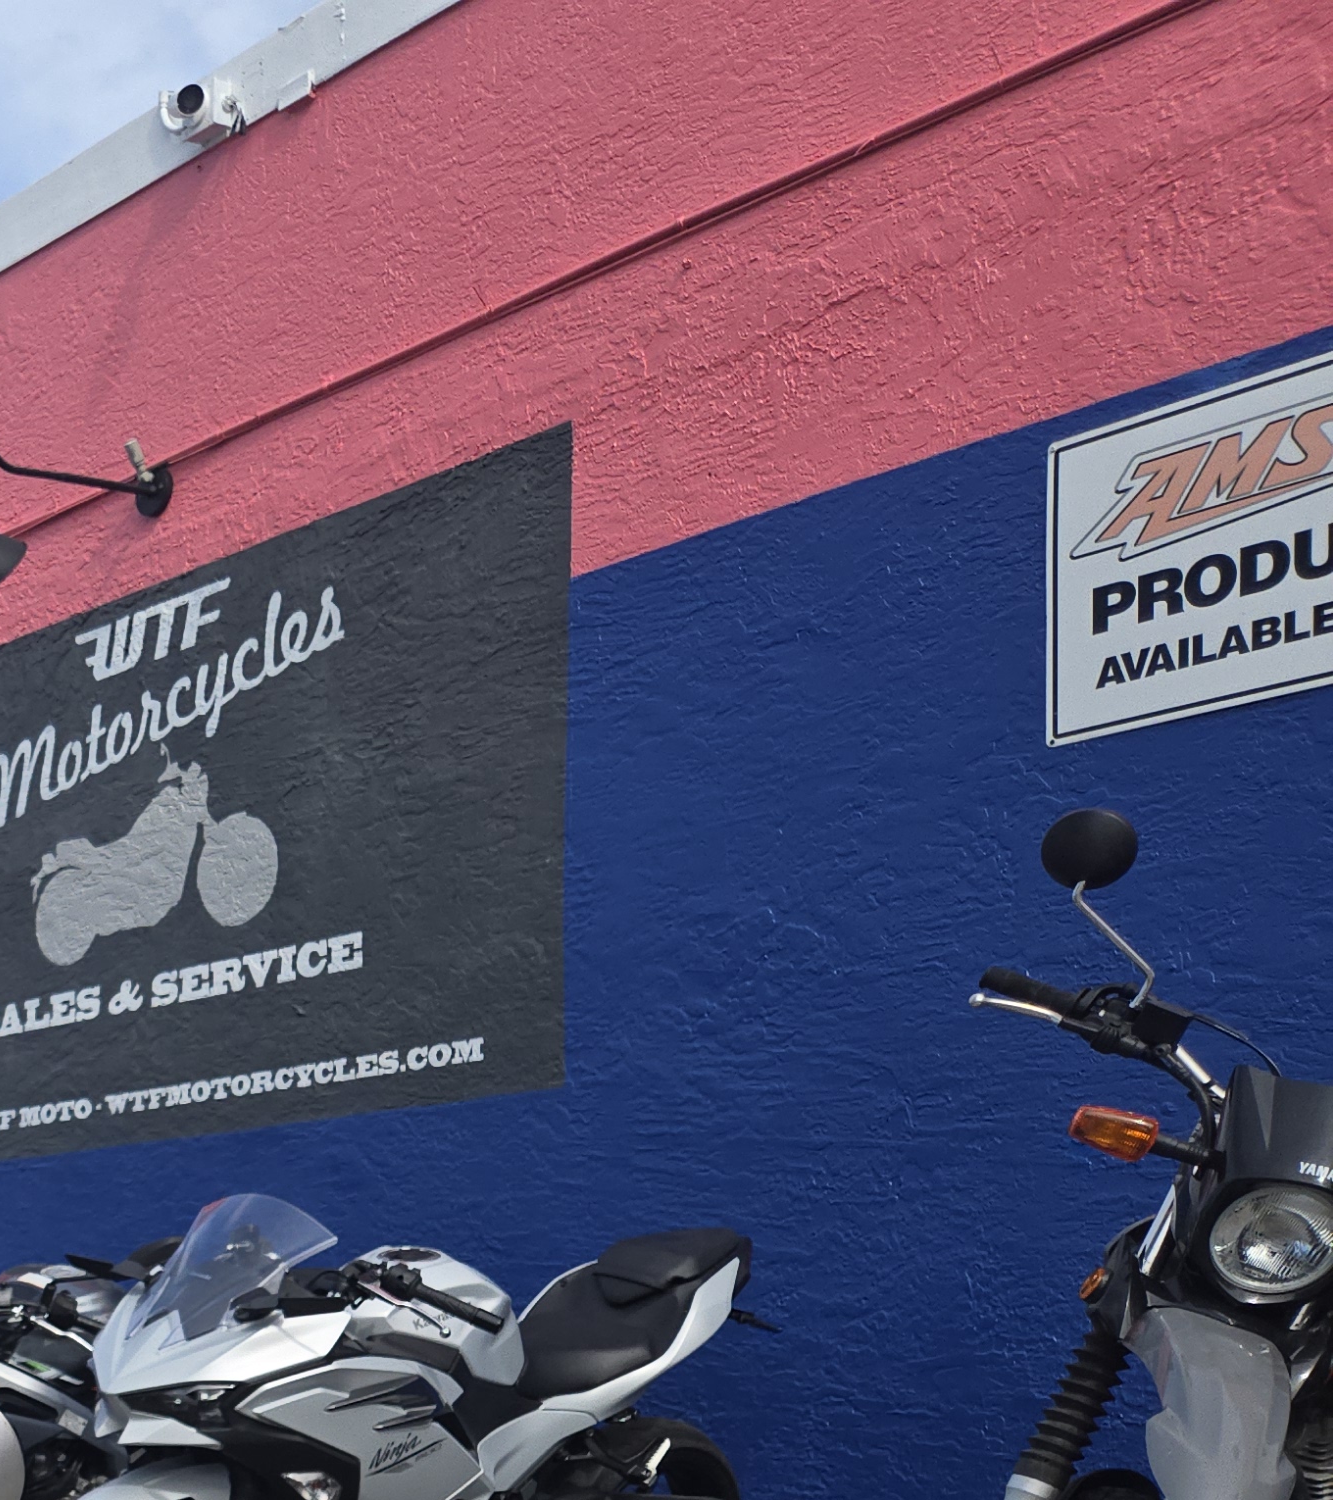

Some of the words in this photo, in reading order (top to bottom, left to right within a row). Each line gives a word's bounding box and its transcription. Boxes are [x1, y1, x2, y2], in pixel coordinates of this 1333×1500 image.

[75, 577, 231, 681] WTF
[1095, 602, 1333, 689] AVAILABLE
[108, 980, 143, 1015] &
[151, 931, 363, 1008] SERVICE
[18, 1098, 92, 1128] MOTO
[105, 1037, 484, 1116] WTFMOTORCYCLES.COM
[368, 1431, 421, 1470] Ninja
